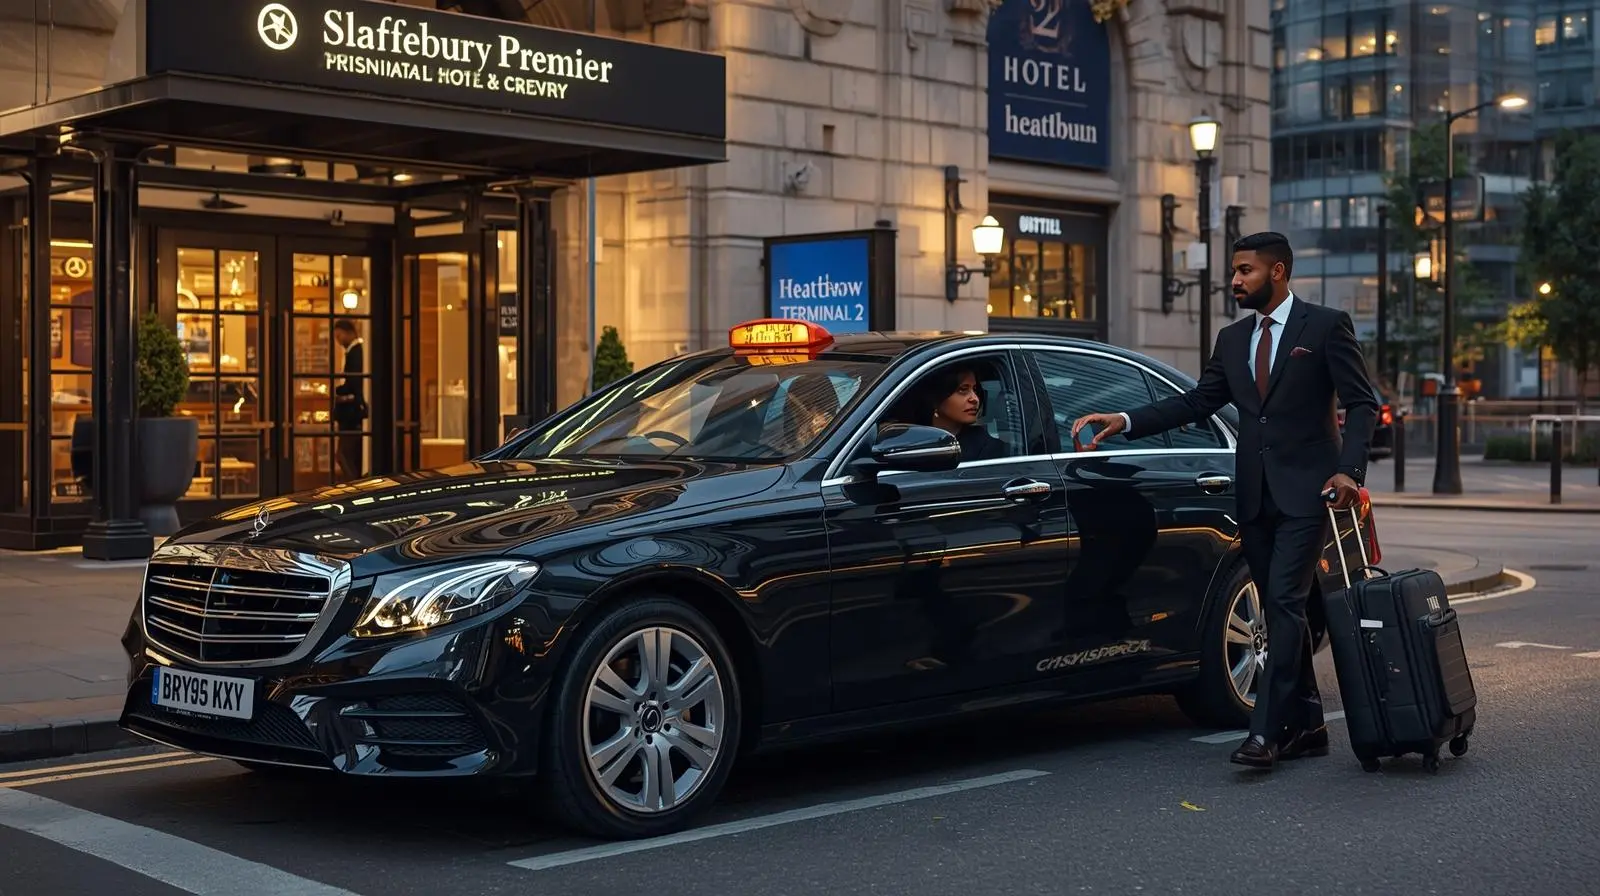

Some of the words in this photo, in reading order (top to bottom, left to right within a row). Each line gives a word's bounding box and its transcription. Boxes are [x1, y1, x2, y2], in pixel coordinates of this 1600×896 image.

[323, 9, 492, 72] Slaffebury
[498, 35, 613, 83] Premier
[487, 73, 499, 90] &
[1004, 55, 1086, 93] HOTEL
[780, 304, 851, 321] TERMINAL
[854, 303, 864, 321] 2
[212, 680, 244, 711] KXY
